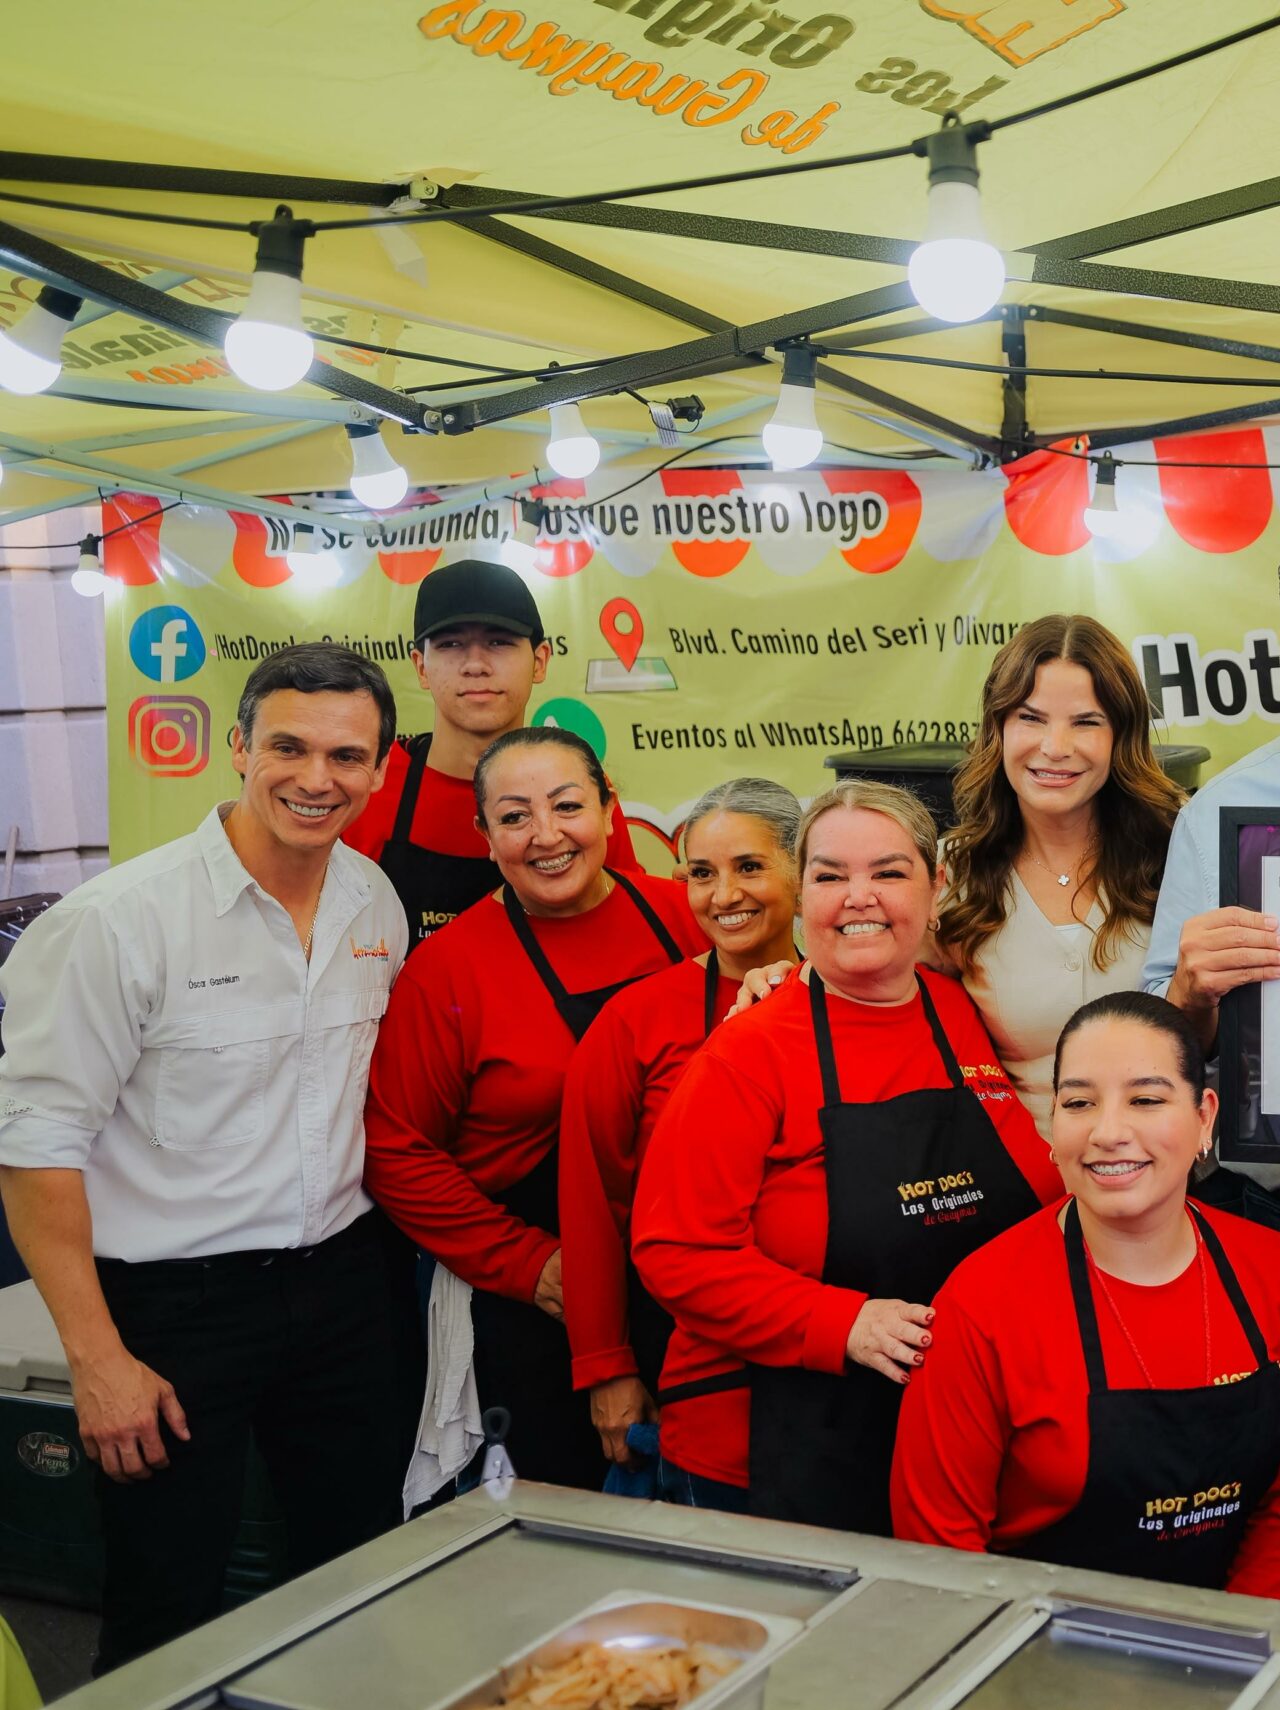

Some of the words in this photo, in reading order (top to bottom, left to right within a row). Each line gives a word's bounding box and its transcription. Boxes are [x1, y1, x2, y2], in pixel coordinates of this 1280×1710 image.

[653, 493, 789, 536] nuestro
[799, 491, 884, 543] logo
[669, 627, 726, 655] Blvd.
[731, 627, 819, 655] Camino
[828, 626, 868, 654] del
[872, 617, 928, 649] Seri
[937, 622, 946, 652] y
[953, 614, 1020, 646] Olivar
[631, 722, 726, 751] Eventos
[735, 719, 756, 749] al
[761, 718, 884, 751] WhatsApp
[898, 1180, 935, 1202] HOT
[901, 1202, 926, 1217] Los
[931, 1189, 984, 1212] Originales
[1138, 1516, 1164, 1531] Los
[1173, 1500, 1241, 1528] Originales
[1146, 1497, 1188, 1517] HOT
